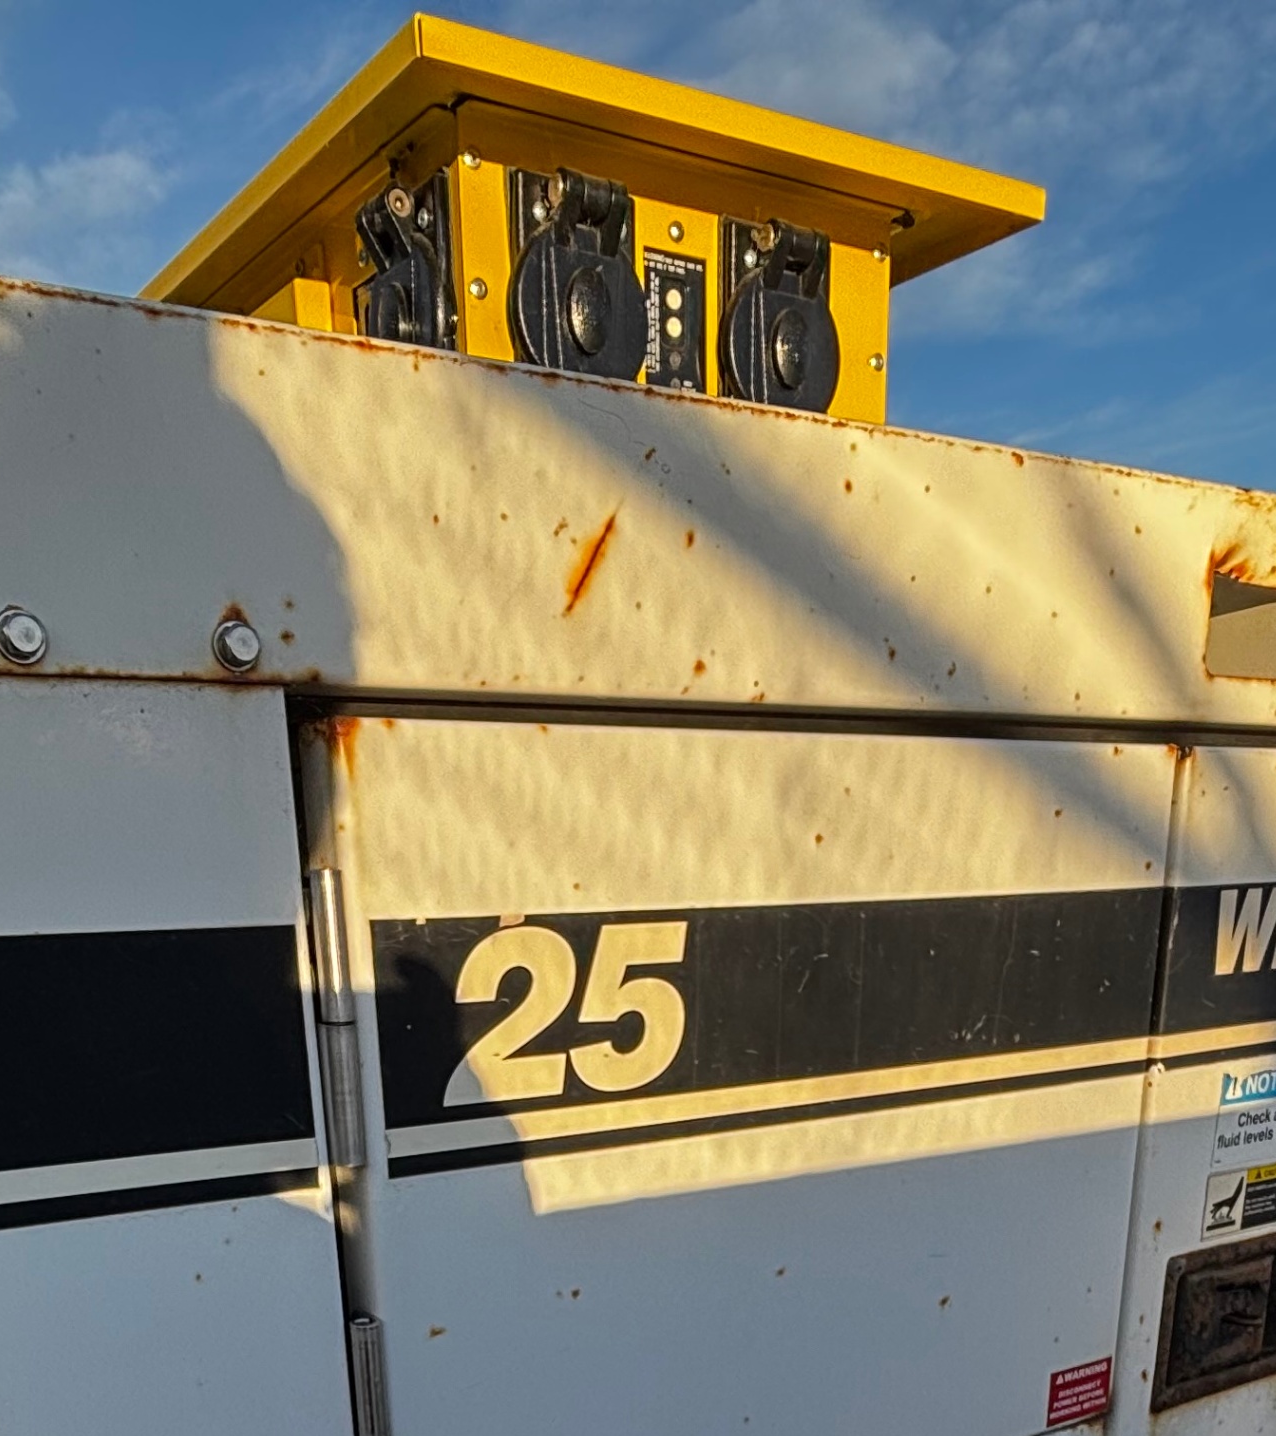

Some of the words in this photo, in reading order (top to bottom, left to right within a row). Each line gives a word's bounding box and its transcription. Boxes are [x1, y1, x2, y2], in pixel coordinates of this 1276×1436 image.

[443, 920, 689, 1108] 25
[1237, 1108, 1271, 1127] Check
[1216, 1131, 1241, 1149] fluid
[1243, 1127, 1274, 1145] levels
[1064, 1361, 1108, 1382] WARNING
